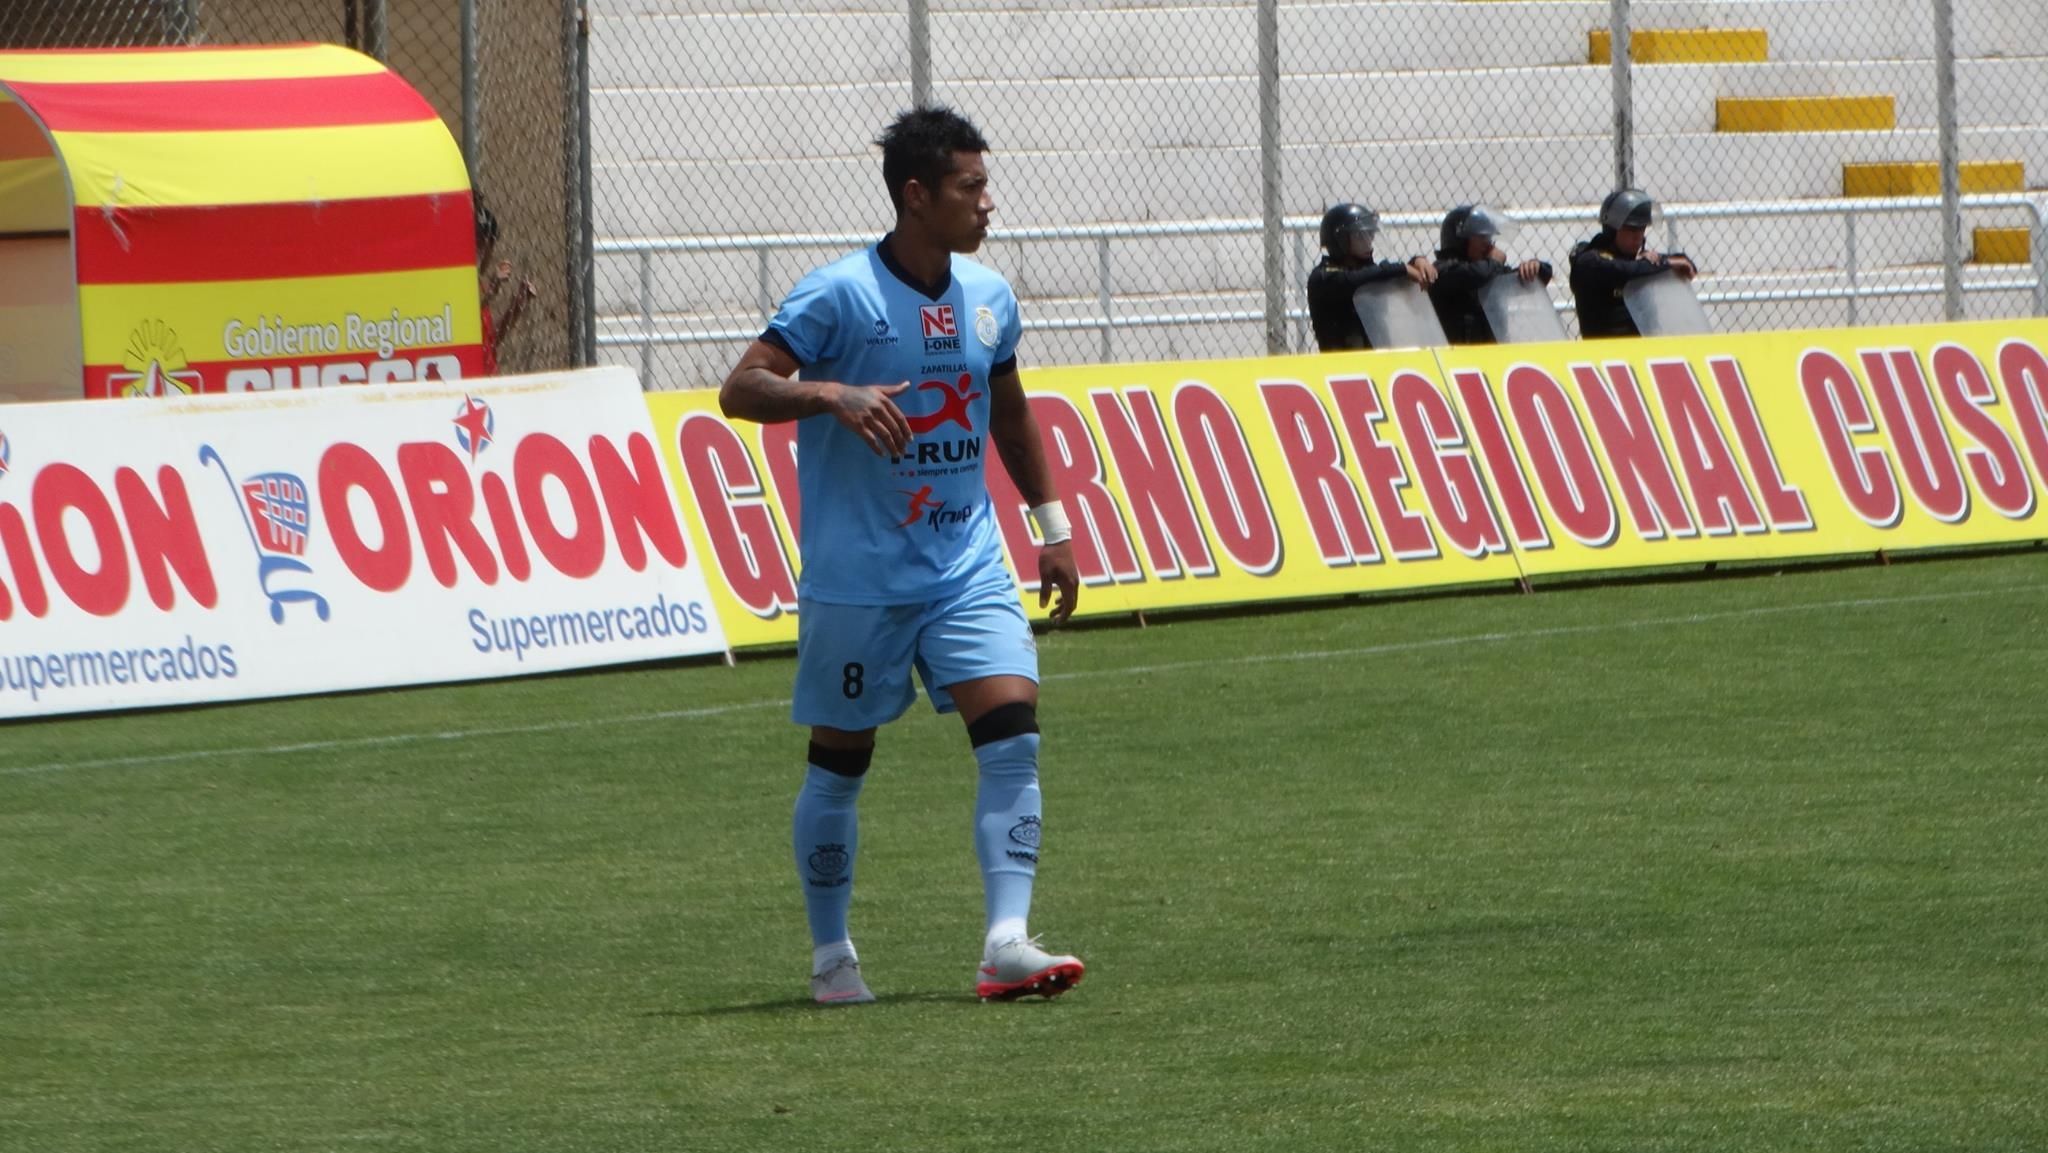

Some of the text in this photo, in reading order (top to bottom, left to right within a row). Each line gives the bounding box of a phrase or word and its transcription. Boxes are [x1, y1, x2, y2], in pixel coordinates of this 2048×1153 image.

[224, 304, 453, 359] Gobierno Regional
[921, 363, 968, 374] ZAPATILLAS
[1257, 356, 1813, 567] REGIONAL
[468, 593, 707, 662] Supermercados
[843, 662, 864, 699] 8
